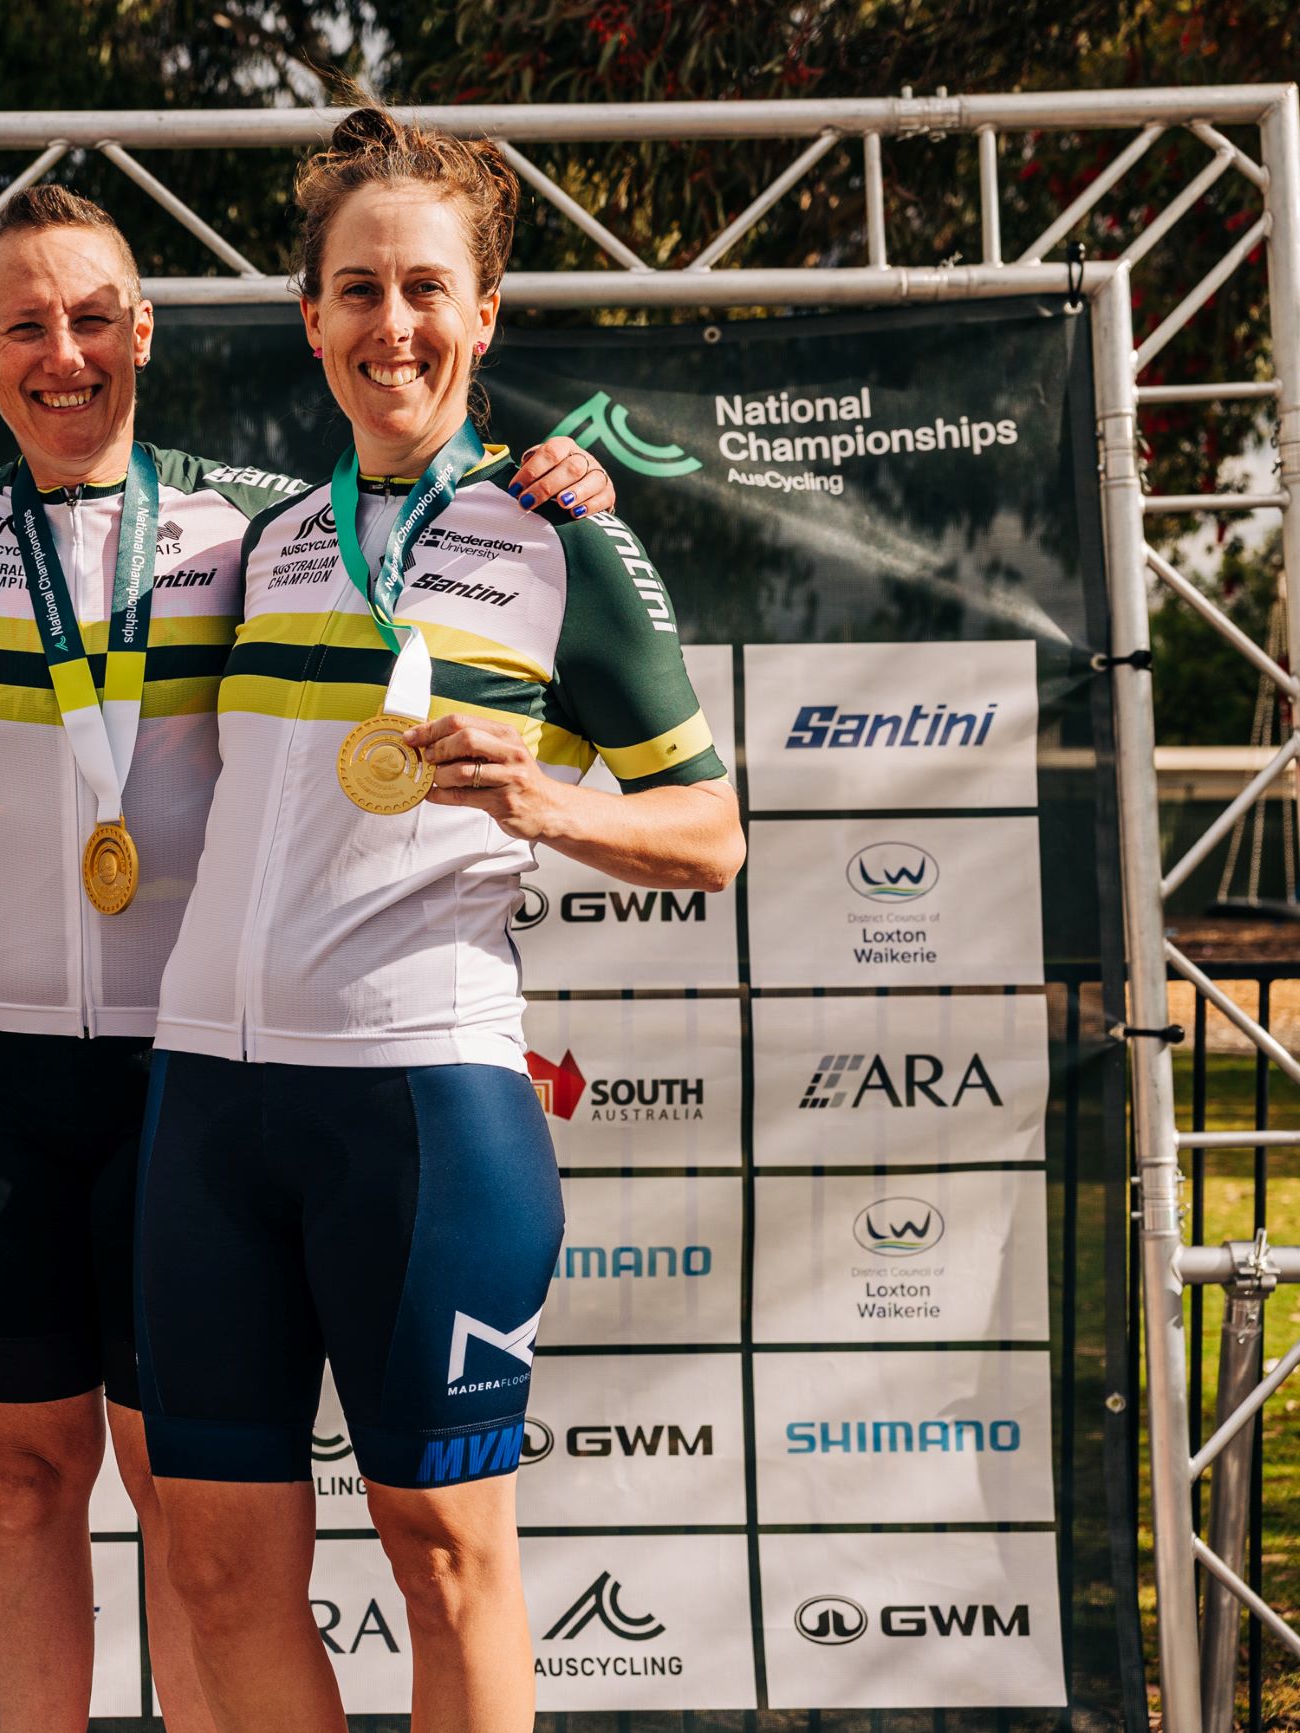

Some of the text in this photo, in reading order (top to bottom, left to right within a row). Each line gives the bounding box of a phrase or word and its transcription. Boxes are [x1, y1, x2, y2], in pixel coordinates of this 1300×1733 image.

[716, 387, 871, 426] National
[718, 418, 1018, 466] Championships
[728, 468, 844, 494] AusCycling
[384, 463, 454, 591] National Championships
[281, 539, 339, 557] AUSCYCLIN
[440, 541, 499, 560] University
[444, 531, 523, 554] Federation
[24, 509, 63, 637] National Championships
[122, 507, 149, 643] National Championships
[268, 570, 332, 590] CHAMPION
[273, 555, 339, 577] AUSTRALIAN
[411, 573, 519, 607] Santini
[786, 703, 998, 749] Santini
[561, 891, 706, 923] GWM
[863, 928, 926, 944] Loxton
[854, 948, 937, 964] Waikerie
[591, 1078, 703, 1106] SOUTH
[852, 1053, 1003, 1108] ARA
[592, 1109, 703, 1121] AUSTRALIA
[866, 1282, 931, 1297] Loxton
[857, 1302, 940, 1319] Waikerie
[567, 1425, 712, 1456] GWM
[786, 1420, 1021, 1453] SHIMANO
[881, 1604, 1029, 1637] GWM
[534, 1656, 683, 1677] AUSCYCLING
